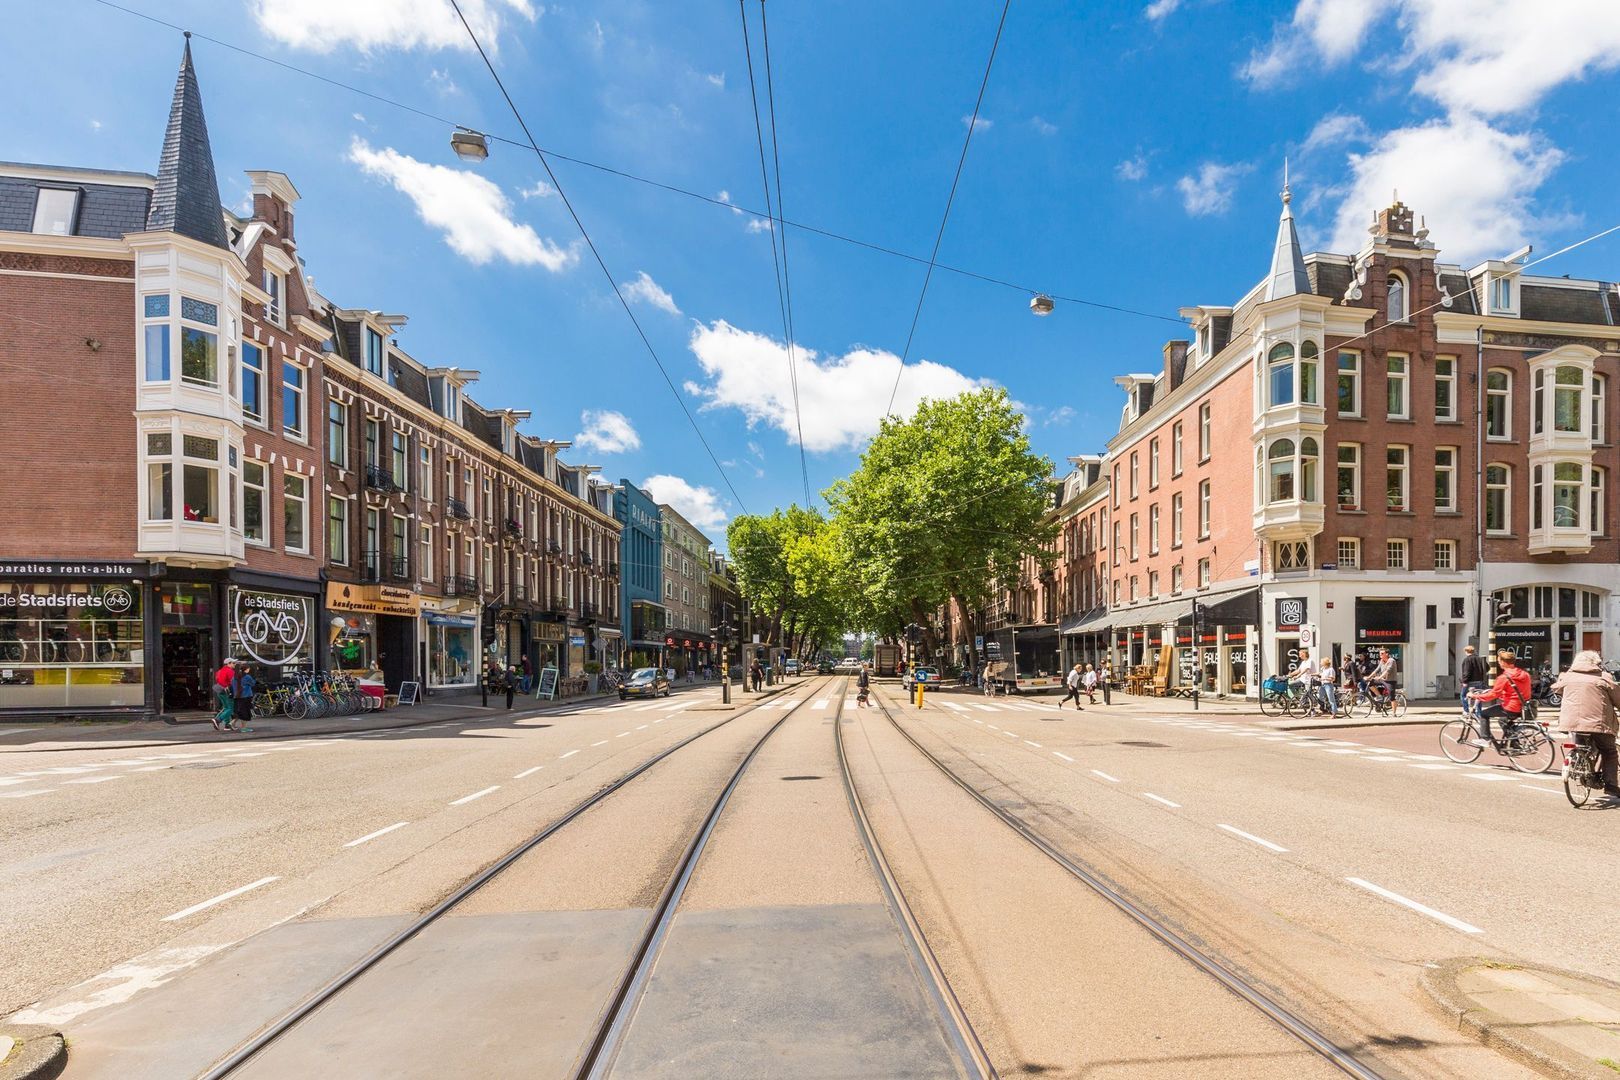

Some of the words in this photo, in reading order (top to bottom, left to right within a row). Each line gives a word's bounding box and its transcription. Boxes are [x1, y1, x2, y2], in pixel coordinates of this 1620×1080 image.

[60, 565, 133, 574] rent-a-bike
[0, 593, 16, 607] de
[19, 593, 102, 607] Stadsfiets
[244, 596, 256, 607] de
[256, 596, 300, 611] Stadsfiets
